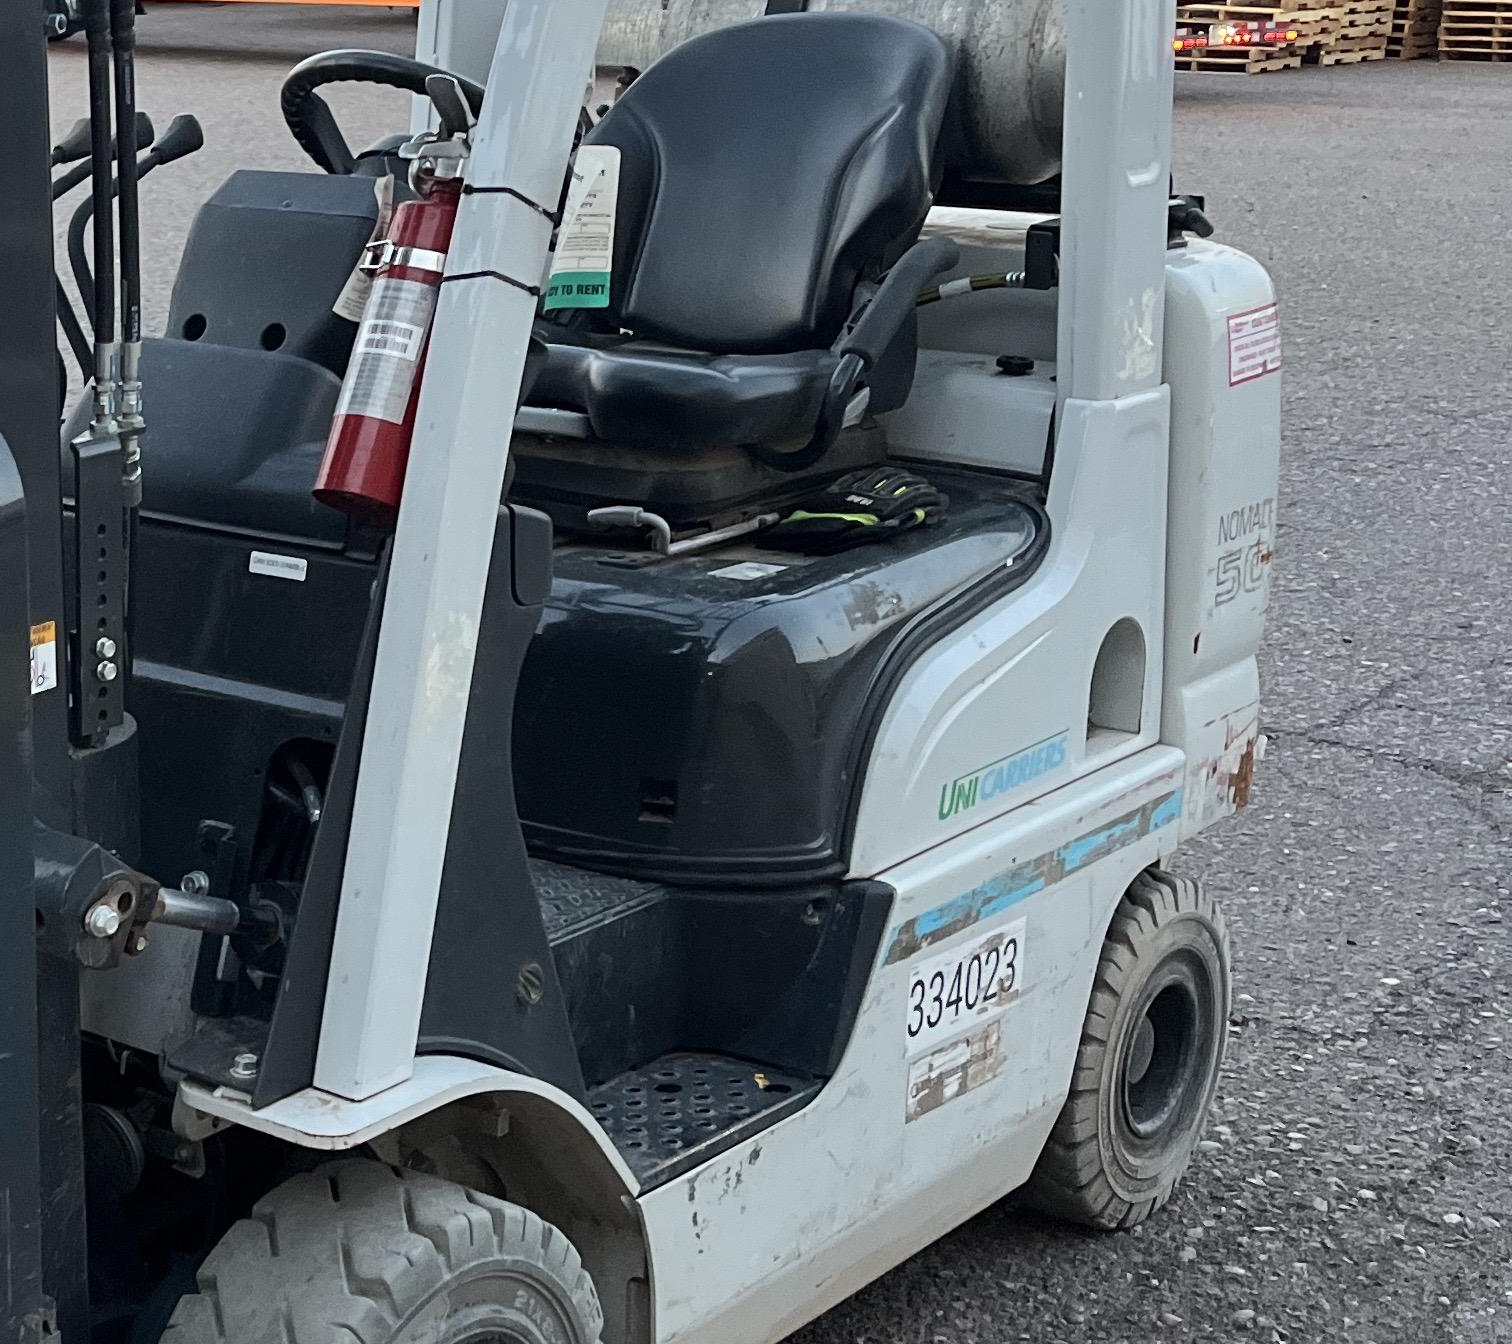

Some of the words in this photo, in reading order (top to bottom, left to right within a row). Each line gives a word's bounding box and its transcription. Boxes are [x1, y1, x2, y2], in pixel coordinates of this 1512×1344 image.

[561, 284, 573, 295] TO
[577, 284, 606, 295] RENT
[907, 937, 1018, 1038] 334023
